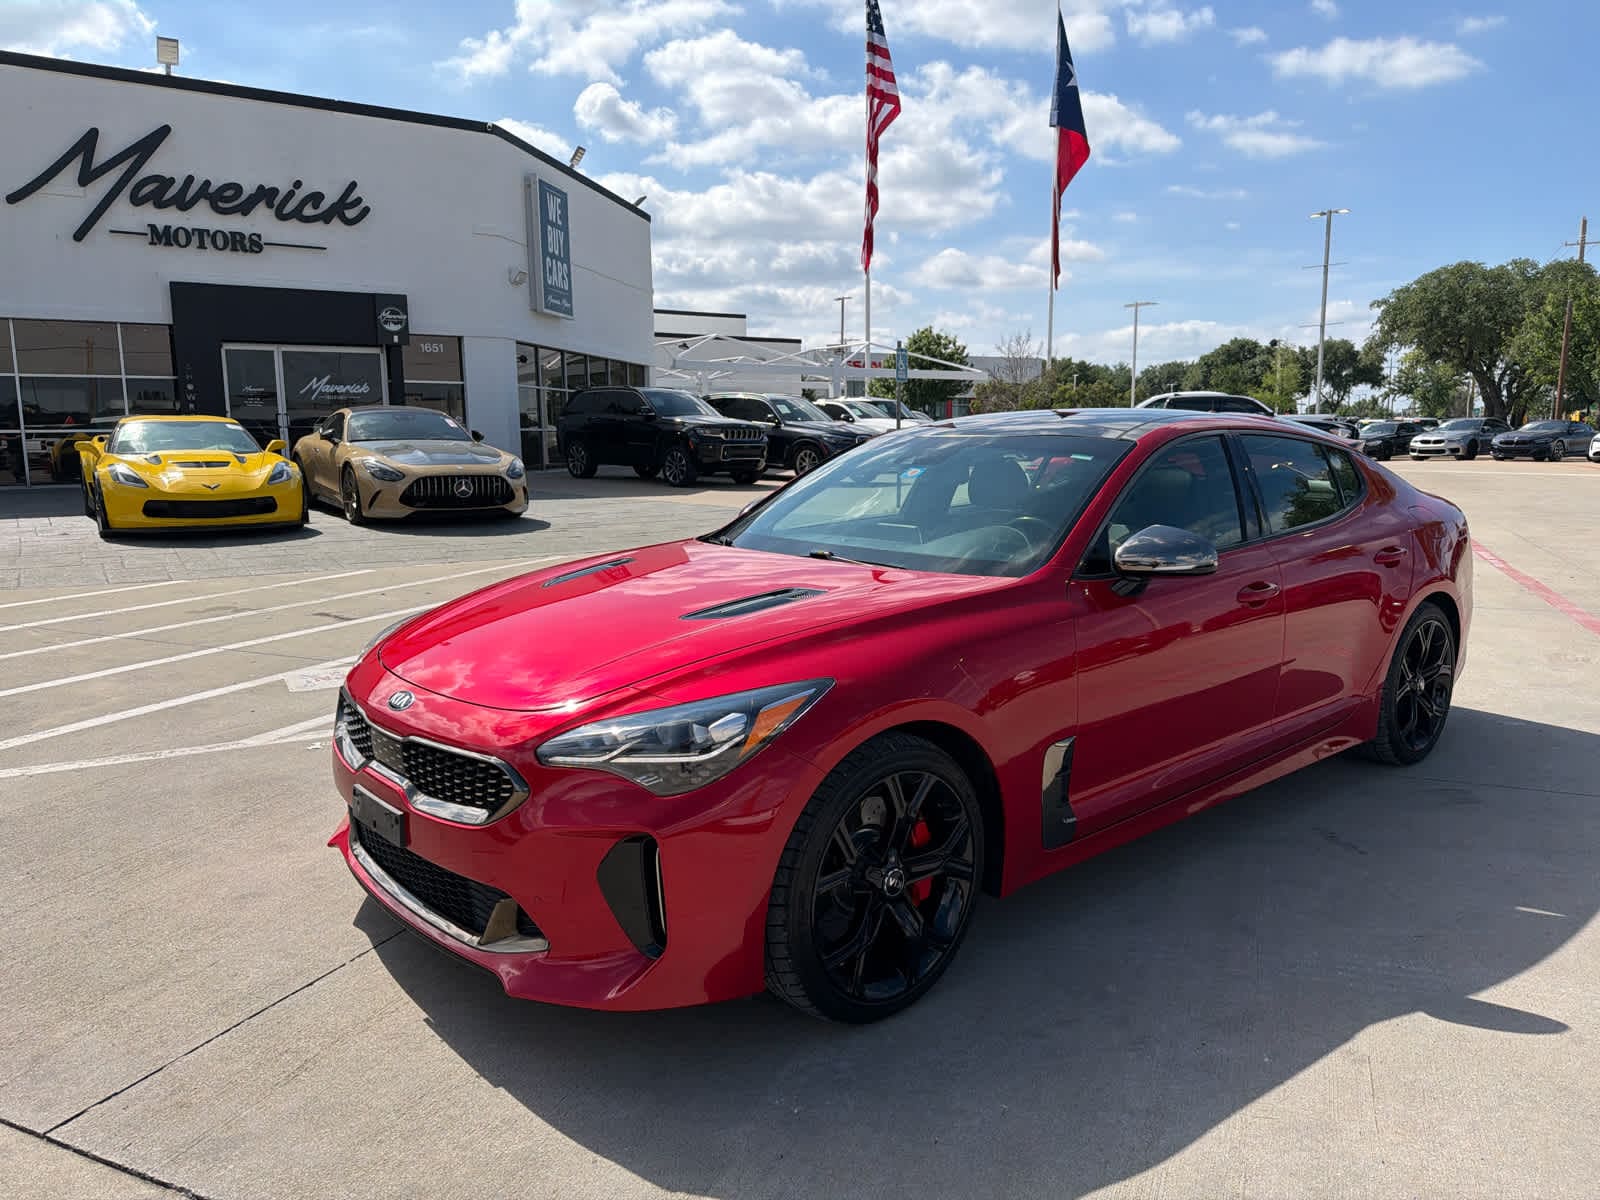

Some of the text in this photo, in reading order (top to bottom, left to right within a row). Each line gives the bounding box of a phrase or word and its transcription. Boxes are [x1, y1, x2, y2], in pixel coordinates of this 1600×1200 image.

[6, 124, 371, 242] Maverick
[546, 192, 562, 224] WE
[147, 224, 264, 254] MOTORS
[546, 225, 564, 258] BUY
[545, 256, 569, 291] CARS
[420, 343, 444, 353] 1651
[299, 375, 370, 400] Maverick
